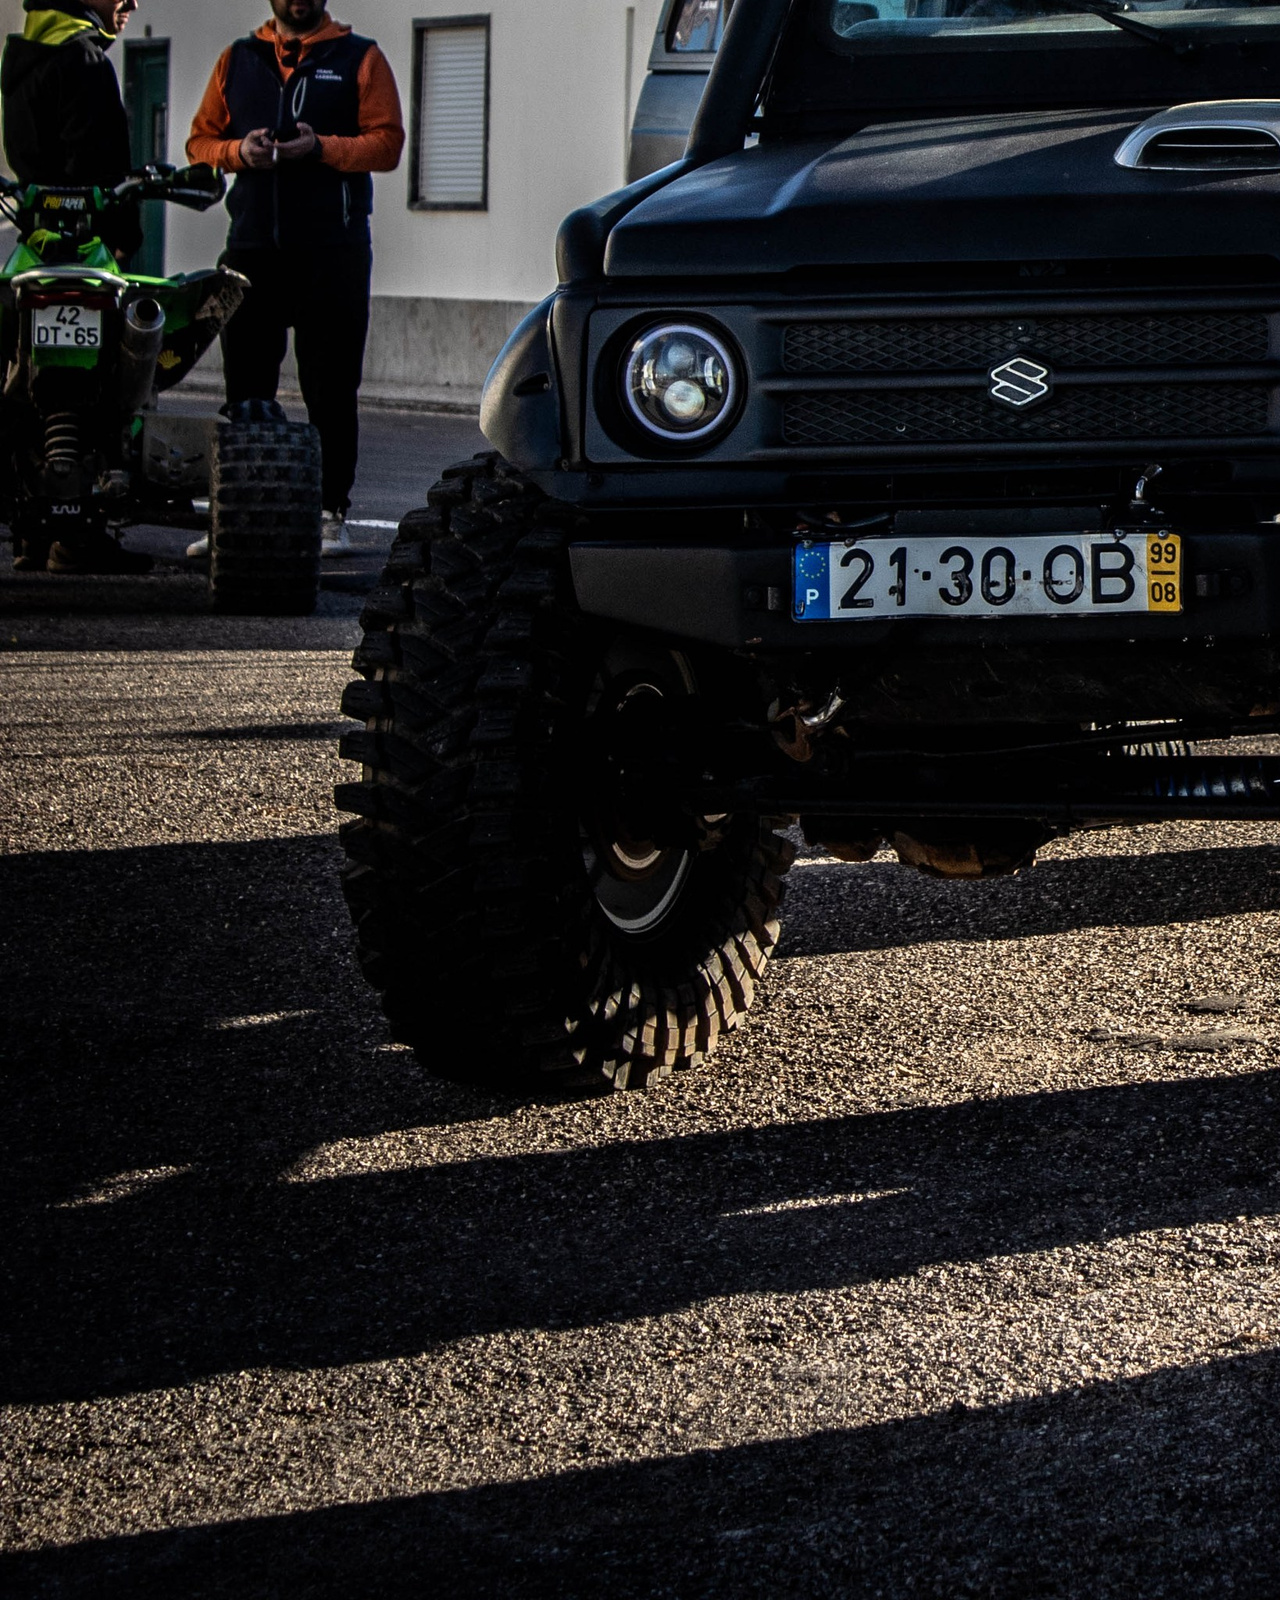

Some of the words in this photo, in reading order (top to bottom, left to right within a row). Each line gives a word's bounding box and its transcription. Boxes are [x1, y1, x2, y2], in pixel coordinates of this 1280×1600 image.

[56, 306, 80, 325] 42
[1150, 542, 1176, 563] 99
[806, 589, 819, 605] P
[1151, 582, 1176, 602] 08
